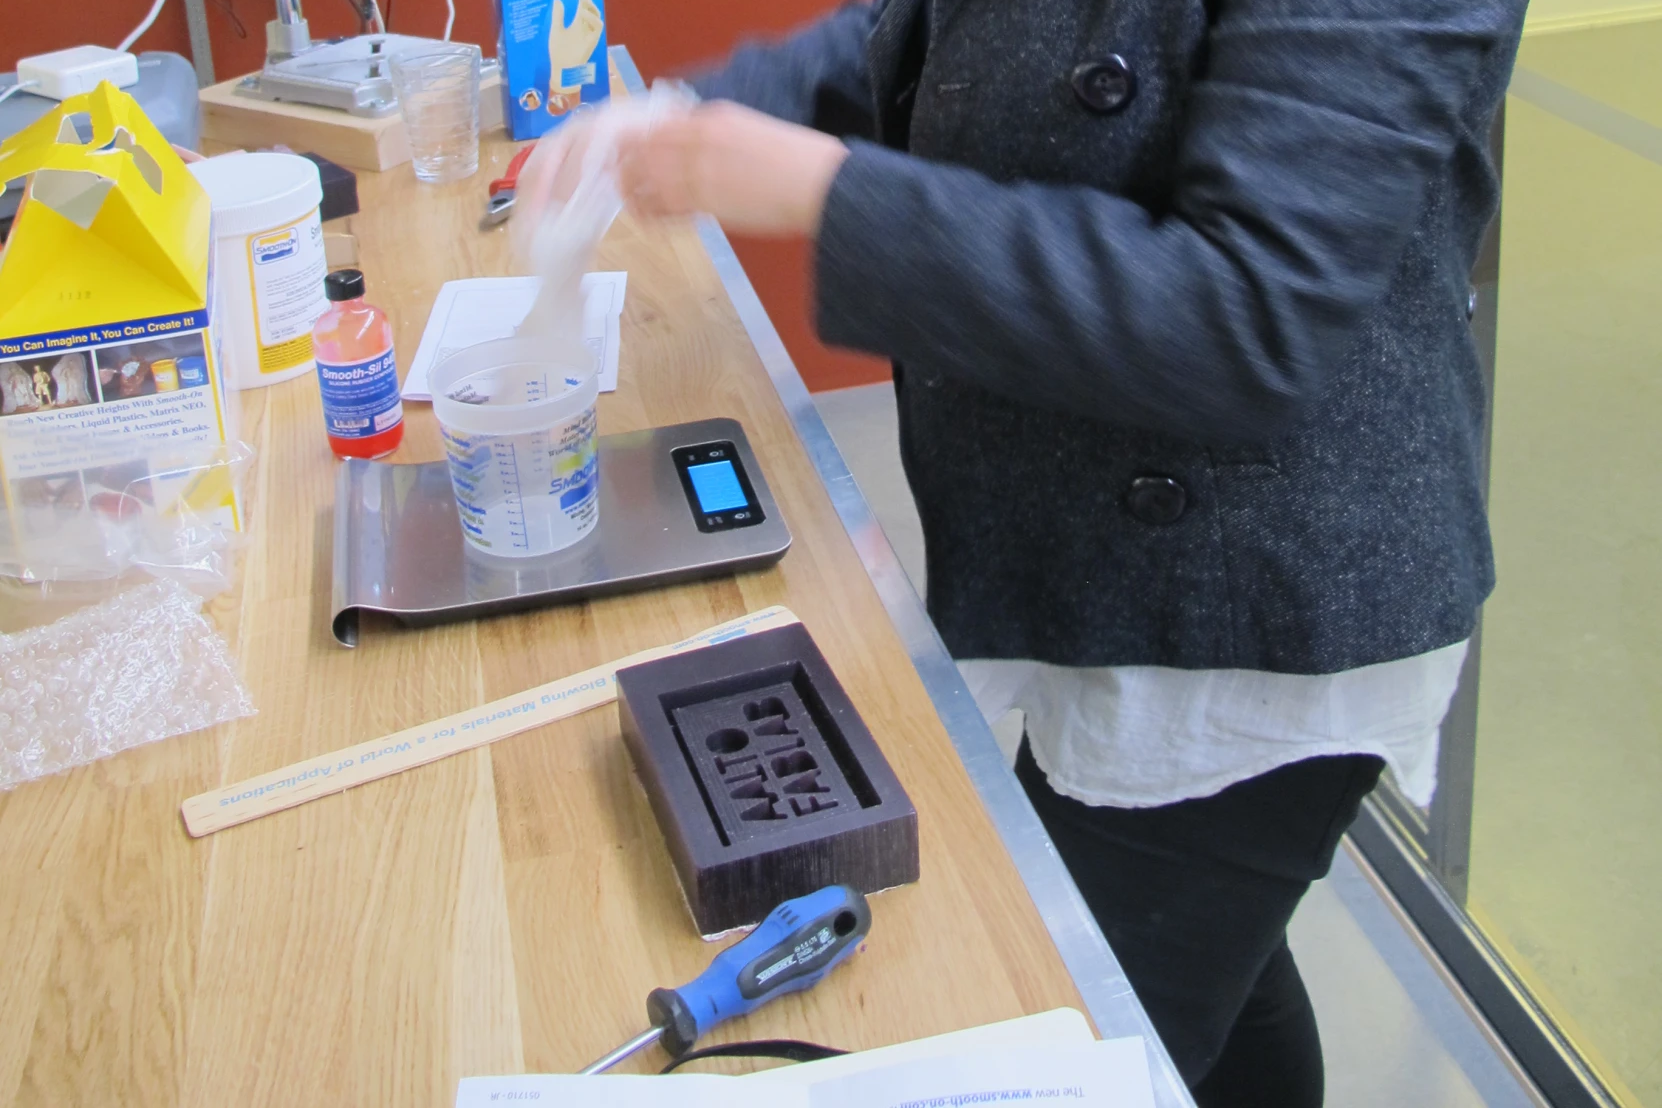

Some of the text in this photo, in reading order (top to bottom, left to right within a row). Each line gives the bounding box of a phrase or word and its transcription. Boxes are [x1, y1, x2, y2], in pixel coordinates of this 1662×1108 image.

[0, 316, 195, 354] You Can Imagine It, You Can Create It!
[322, 360, 382, 380] Smooth-Sil
[36, 414, 55, 423] New
[57, 409, 95, 420] Creative
[97, 403, 130, 416] Heights
[132, 399, 154, 409] With
[155, 391, 203, 405] Smooth-On
[81, 419, 110, 430] Liquid
[150, 408, 179, 418] Matrix
[219, 677, 607, 807] Blowing Materials for a World of Applications
[743, 696, 839, 817] FABLAB
[705, 728, 788, 821] AALTO
[1034, 1088, 1061, 1099] new
[1062, 1086, 1085, 1098] The
